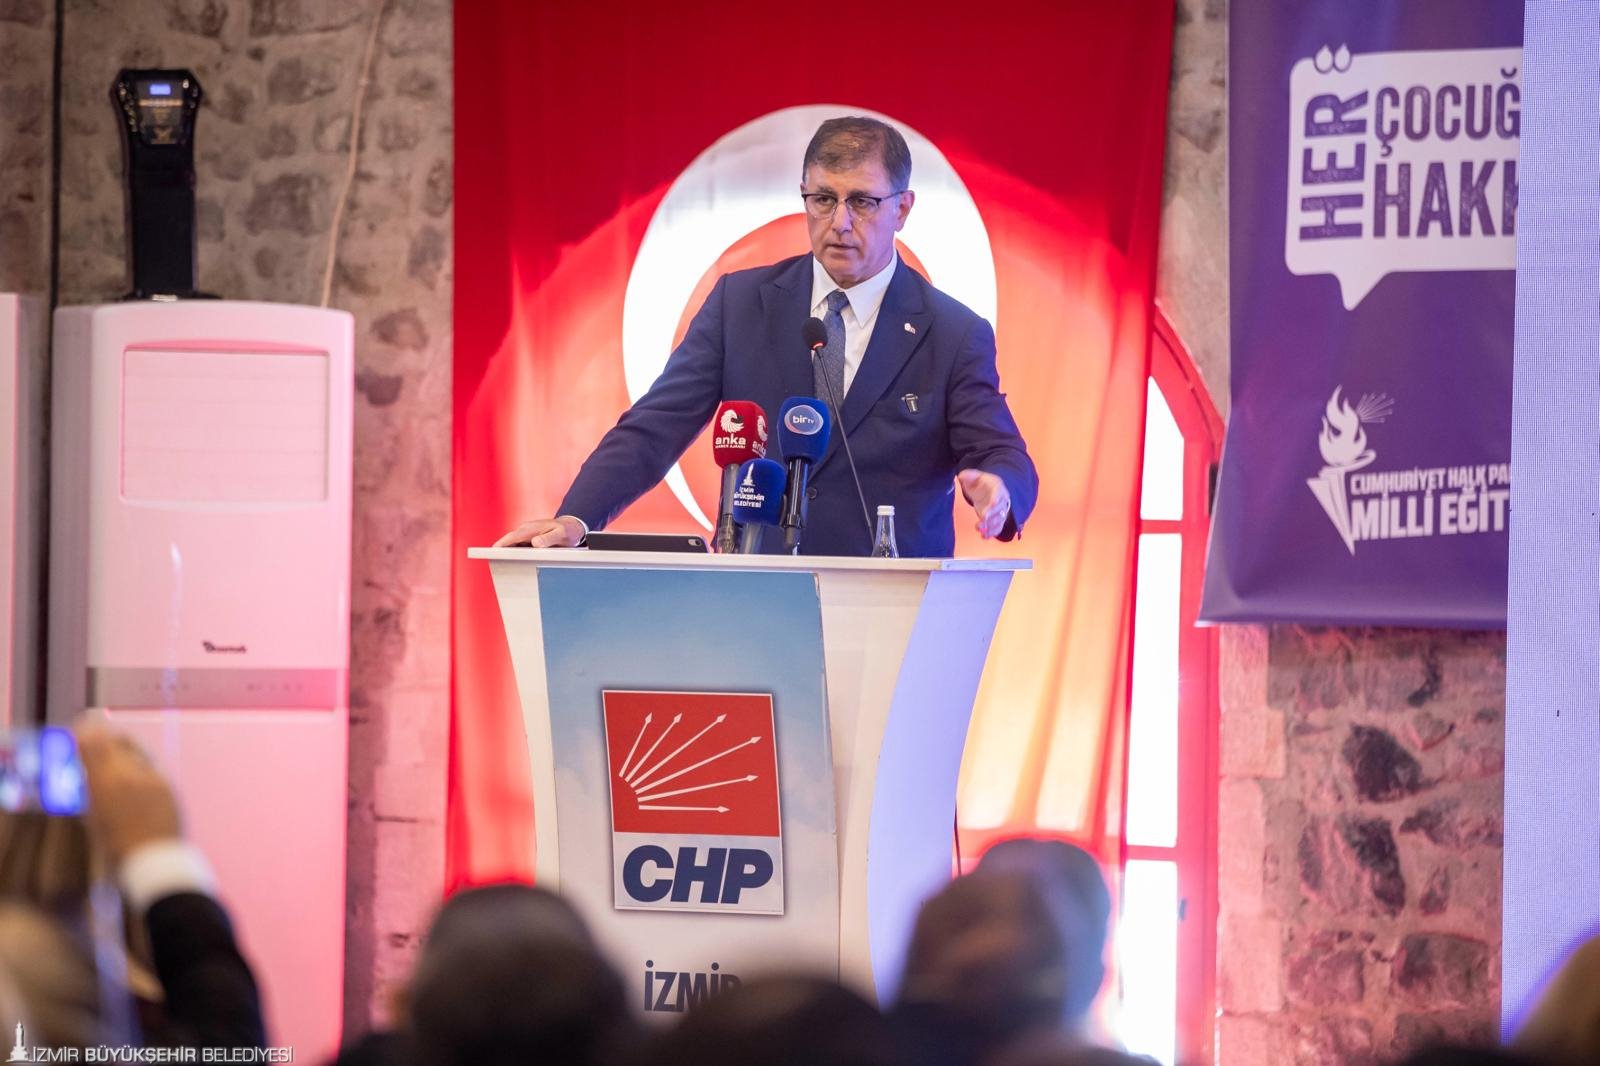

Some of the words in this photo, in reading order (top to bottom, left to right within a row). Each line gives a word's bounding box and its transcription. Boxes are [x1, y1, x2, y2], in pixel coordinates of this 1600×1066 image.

[1375, 67, 1520, 157] ÇOCUĞ
[1299, 90, 1368, 241] HER
[715, 433, 746, 445] anka
[1351, 467, 1446, 495] CUMHURİYET
[1448, 464, 1488, 489] HALK
[1488, 463, 1511, 486] PA
[623, 845, 773, 904] CHP
